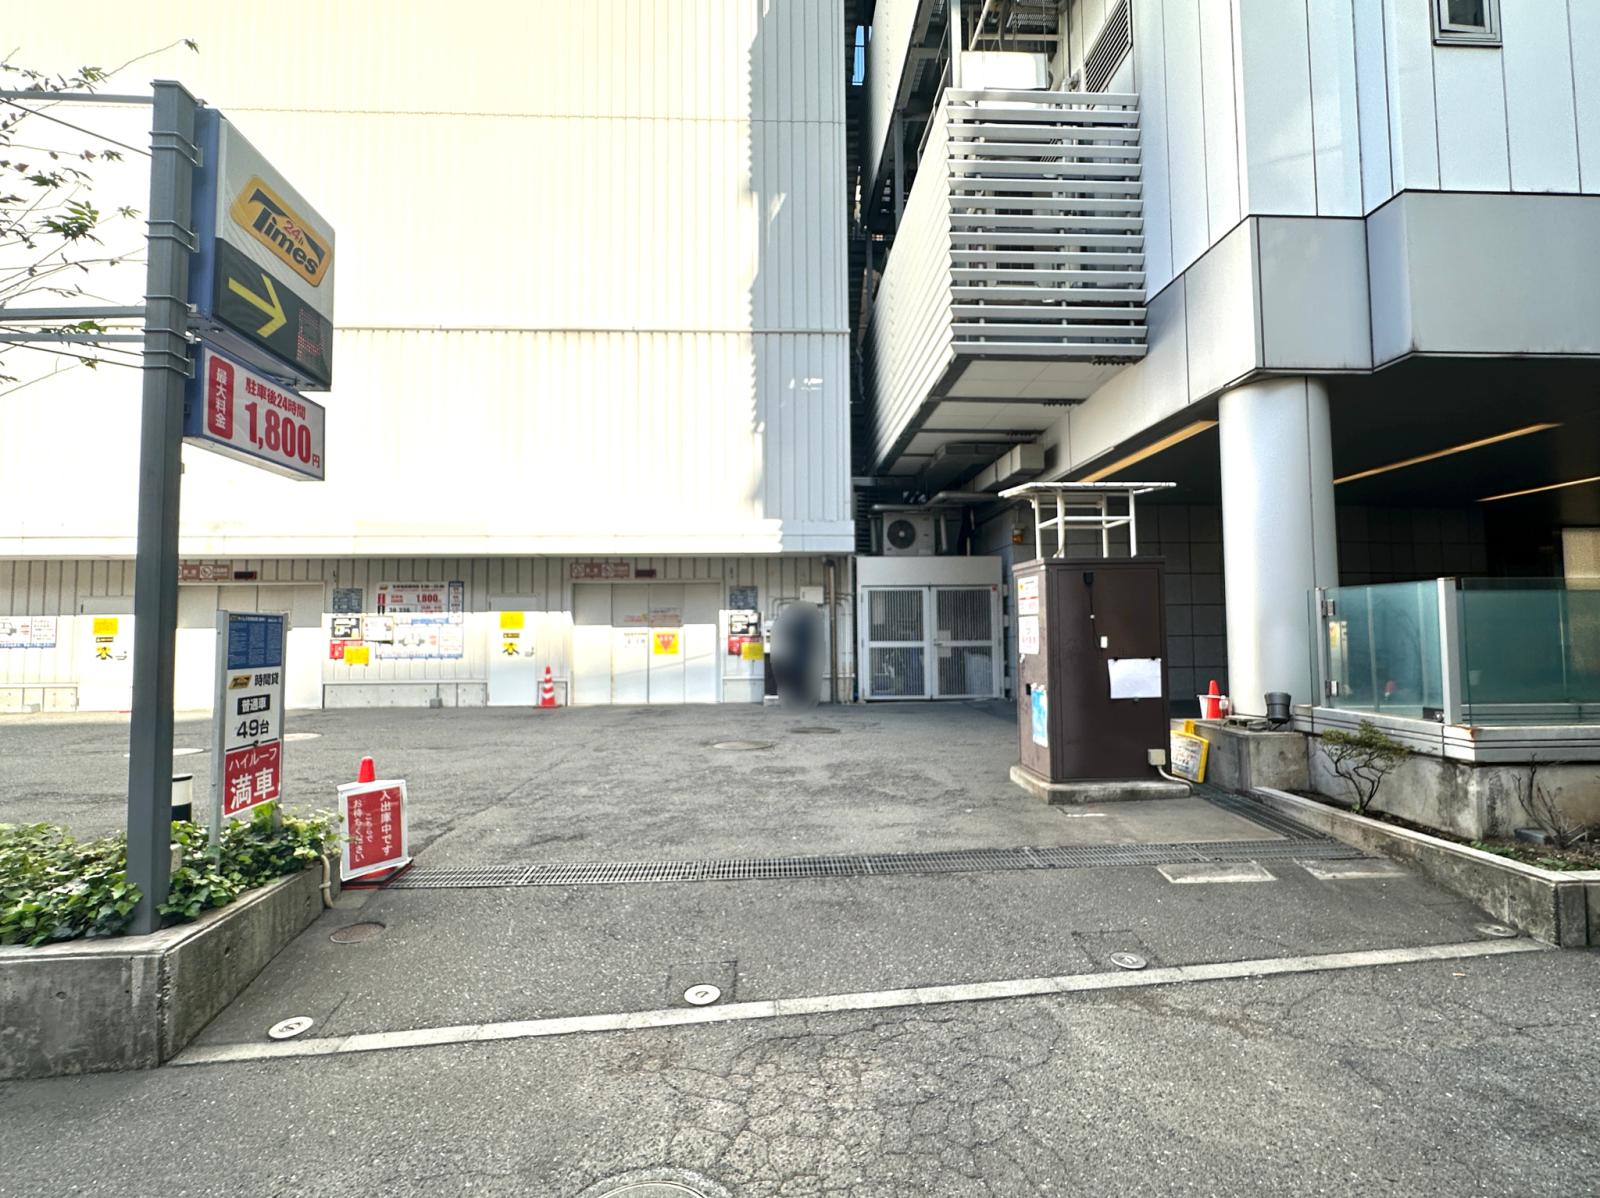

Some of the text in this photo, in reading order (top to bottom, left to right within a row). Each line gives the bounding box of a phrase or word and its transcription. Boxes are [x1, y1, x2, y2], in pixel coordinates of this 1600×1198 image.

[248, 188, 326, 275] Times
[215, 367, 228, 430] 最大料金
[246, 377, 306, 420] 駐車後24時間
[254, 671, 279, 687] 時間貸
[241, 696, 267, 713] 普通車
[236, 718, 270, 739] 49台
[228, 747, 278, 771] ハイルーフ
[230, 766, 275, 810] 満車
[380, 790, 393, 857] 入出庫中です
